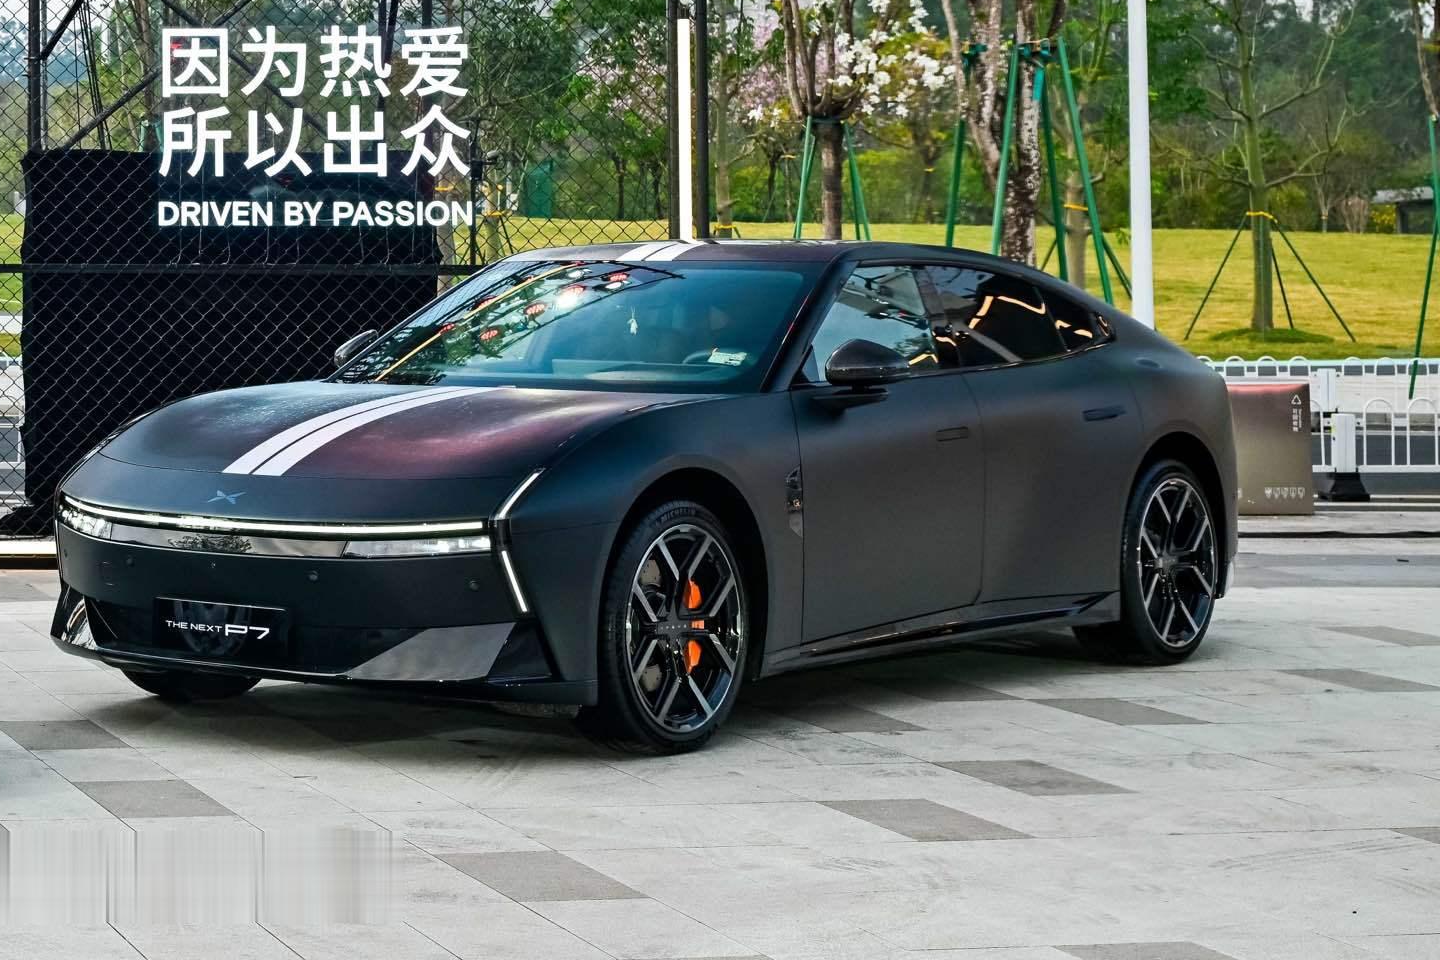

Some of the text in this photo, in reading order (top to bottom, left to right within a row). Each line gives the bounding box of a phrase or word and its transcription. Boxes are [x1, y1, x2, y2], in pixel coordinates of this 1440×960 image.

[162, 25, 469, 98] 因为热爱
[158, 104, 472, 178] 所以出众
[157, 201, 474, 227] DRIVEN BY PASSION
[165, 620, 270, 639] THE NEXT P7
